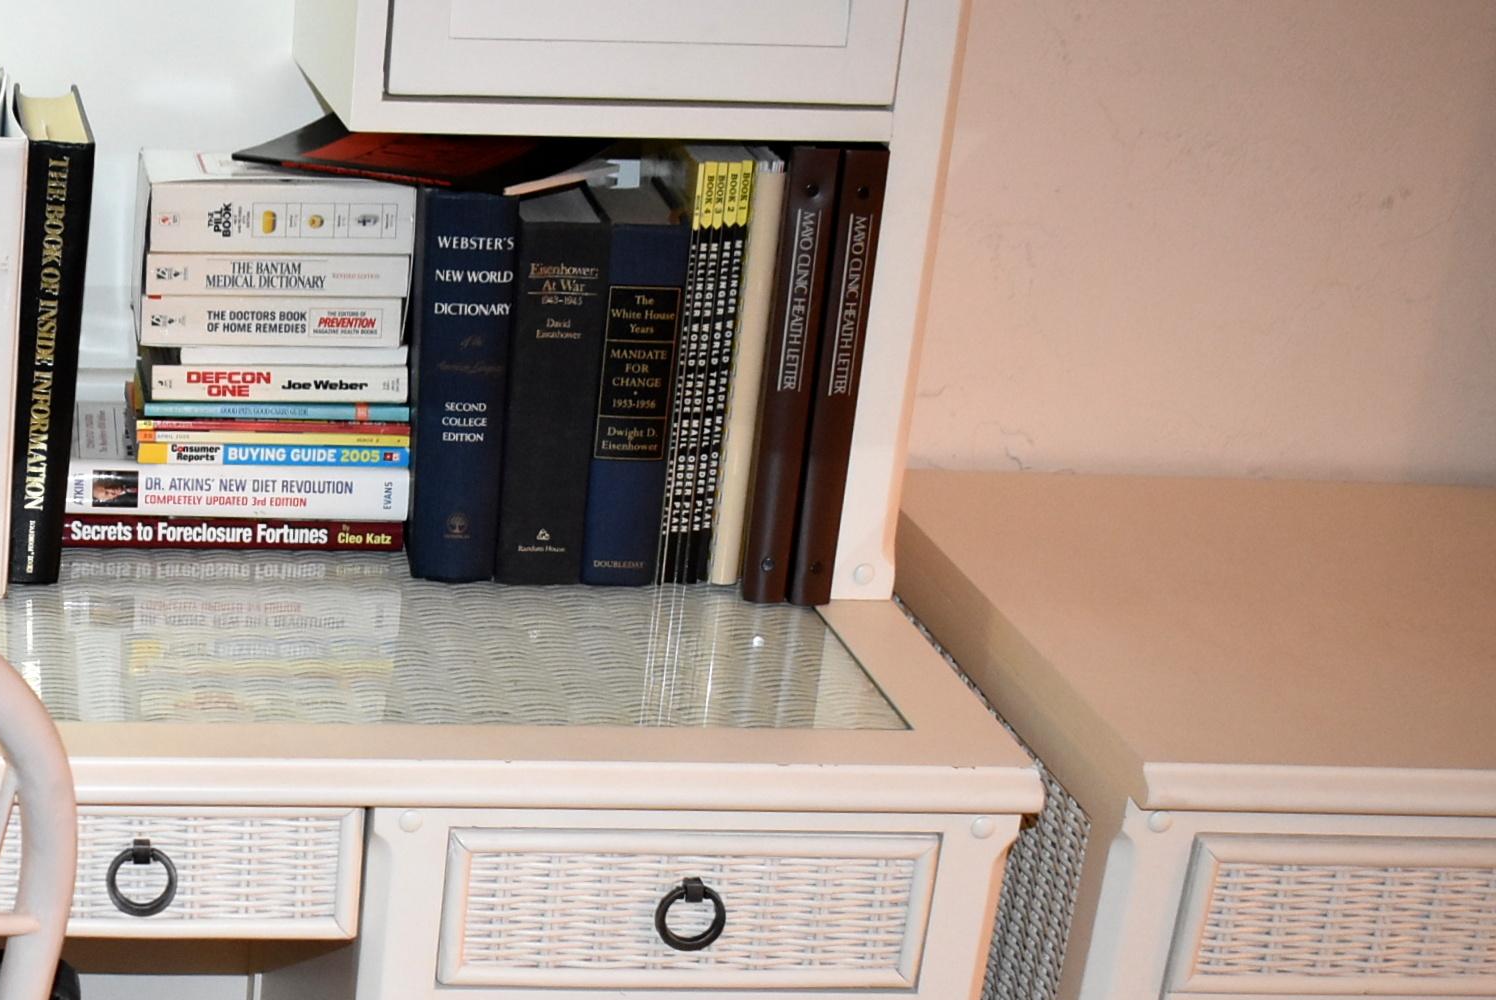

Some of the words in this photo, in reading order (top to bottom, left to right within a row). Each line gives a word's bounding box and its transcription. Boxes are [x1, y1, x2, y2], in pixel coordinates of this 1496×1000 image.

[46, 156, 70, 202] THE
[705, 175, 715, 204] BOOK
[716, 175, 726, 204] BOOK
[729, 173, 739, 203] BOOK
[740, 172, 751, 200] BOOK
[41, 203, 66, 266] BOOK
[213, 207, 223, 233] PILL
[222, 202, 233, 238] BOOK
[799, 211, 817, 251] MAYO
[438, 236, 515, 250] WEBSTER'S
[849, 216, 868, 256] MAYO
[40, 266, 61, 295] OF
[206, 275, 255, 289] MEDICAL
[259, 275, 326, 289] DICTIONARY
[231, 261, 254, 275] THE
[256, 262, 302, 275] BANTAM
[435, 270, 463, 282] NEW
[467, 270, 513, 283] WORLD
[693, 243, 708, 317] MELLINGER
[704, 243, 718, 317] MELLINGER
[716, 241, 731, 315] MELLINGER
[728, 240, 743, 314] MELLINGER
[793, 253, 812, 297] CLINIC
[845, 257, 864, 300] CLINIC
[542, 279, 557, 291] At
[560, 279, 586, 292] War
[634, 295, 654, 305] The
[207, 311, 226, 321] THE
[229, 311, 276, 321] DOCTORS
[279, 311, 307, 321] BOOK
[318, 317, 377, 328] PREVENTION
[434, 303, 511, 315] DICTIONARY
[610, 309, 642, 320] White
[644, 309, 676, 321] House
[787, 299, 806, 345] HEALTH
[35, 299, 59, 366] INSIDE
[207, 322, 219, 333] OF
[222, 322, 252, 333] HOME
[255, 323, 307, 333] REMEDIES
[629, 324, 655, 334] Years
[839, 302, 858, 349] HEALTH
[610, 349, 668, 360] MANDATE
[687, 323, 699, 367] WORLD
[698, 323, 710, 367] WORLD
[710, 322, 722, 365] WORLD
[722, 320, 734, 363] WORLD
[186, 371, 271, 384] DEFCON
[612, 377, 662, 388] CHANGE
[625, 363, 649, 373] FOR
[783, 347, 802, 390] LETTER
[834, 352, 852, 394] LETTER
[207, 385, 250, 397] ONE
[281, 379, 312, 390] Joe
[313, 379, 369, 390] Weber
[683, 373, 694, 413] TRADE
[692, 373, 704, 413] TRADE
[705, 371, 717, 412] TRADE
[716, 369, 728, 410] TRADE
[442, 416, 488, 427] COLLEGE
[445, 402, 487, 412] SECOND
[24, 371, 54, 511] INFORMATION
[442, 432, 484, 442] EDITION
[607, 426, 644, 440] Dwight
[647, 428, 659, 437] D.
[679, 419, 690, 449] MAIL
[688, 419, 699, 449] MAIL
[701, 418, 712, 447] MAIL
[712, 416, 723, 445] MAIL
[171, 444, 220, 453] Consumer
[176, 453, 216, 462] Reports
[227, 448, 287, 462] BUYING
[290, 448, 337, 462] GUIDE
[340, 449, 381, 463] 2005
[601, 440, 658, 451] Eisenhower
[145, 477, 165, 491] DR.
[169, 478, 215, 492] ATKINS'
[219, 478, 247, 492] NEW
[252, 479, 277, 493] DIET
[281, 480, 354, 494] REVOLUTION
[674, 455, 686, 496] ORDER
[684, 455, 695, 496] ORDER
[696, 454, 708, 494] ORDER
[707, 452, 719, 492] ORDER
[144, 494, 202, 505] COMPLETELY
[206, 495, 248, 506] UPDATED
[252, 497, 267, 506] 3rd
[270, 497, 307, 507] EDITION
[383, 482, 394, 510] EVANS
[342, 524, 351, 532] By
[671, 501, 681, 533] PLAN
[680, 501, 691, 533] PLAN
[693, 500, 703, 532] PLAN
[704, 498, 713, 529] PLAN
[70, 520, 132, 541] Secrets
[137, 521, 153, 541] to
[157, 522, 253, 543] Foreclosure
[256, 523, 328, 544] Fortunes
[337, 532, 363, 544] Cleo
[366, 533, 392, 545] Katz
[518, 545, 544, 553] Random
[545, 545, 566, 553] House
[593, 560, 644, 569] DOUBLEDAY
